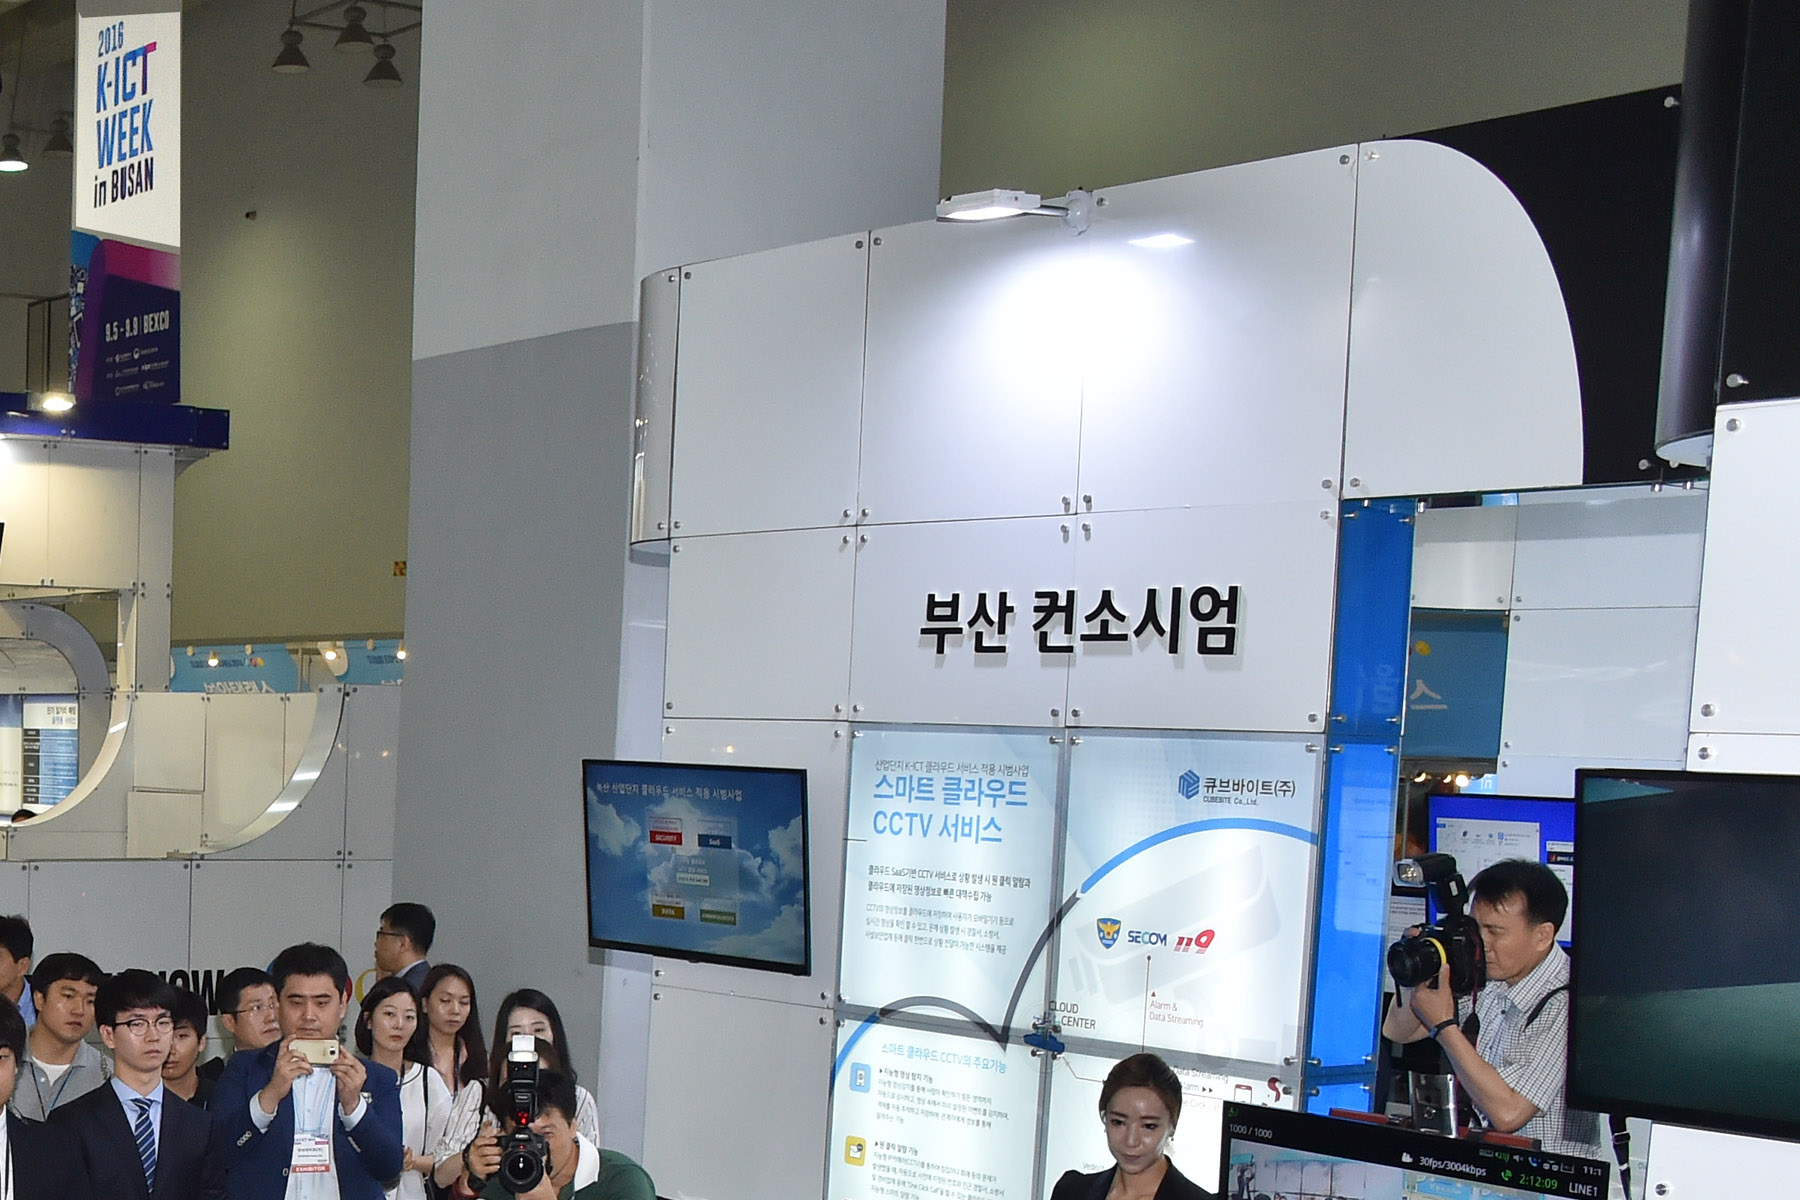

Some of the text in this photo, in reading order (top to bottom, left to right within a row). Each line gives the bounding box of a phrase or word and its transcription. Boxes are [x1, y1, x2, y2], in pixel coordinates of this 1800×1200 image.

[98, 21, 124, 57] 2016
[96, 41, 157, 113] K-ICT
[96, 98, 154, 170] WEEK
[93, 157, 154, 208] in BUSAN
[143, 310, 170, 334] BEXCO
[919, 585, 1240, 656] 부산 컨소시엄
[875, 759, 1029, 778] 산업단지 K-ICT 클라우드 서비스 적용 시범사업
[873, 774, 1028, 808] 스마트 클라우드
[1203, 777, 1296, 799] 큐브바이트(주)
[1203, 796, 1232, 805] CUBEBITE
[873, 810, 1003, 844] CCTV 서비스
[868, 864, 891, 876] 클라우드
[918, 869, 934, 879] CCTV
[935, 870, 957, 881] 서비스로
[1128, 930, 1167, 947] SECOM
[1173, 929, 1215, 954] 119
[1049, 1000, 1079, 1014] CLOUD
[1150, 1000, 1178, 1012] Alarm &
[1061, 1015, 1096, 1030] CENTER
[1150, 1011, 1204, 1028] Data Streaming
[881, 1043, 1008, 1074] 스마트 클라우드 CCTV의 주요기능
[1191, 1067, 1229, 1084] Streaming
[1229, 1122, 1247, 1136] 1000
[1254, 1127, 1273, 1140] 1000
[1418, 1155, 1488, 1177] 30fps/3004kbps
[1519, 1173, 1558, 1190] 2:12:09
[1568, 1181, 1599, 1198] LINE1
